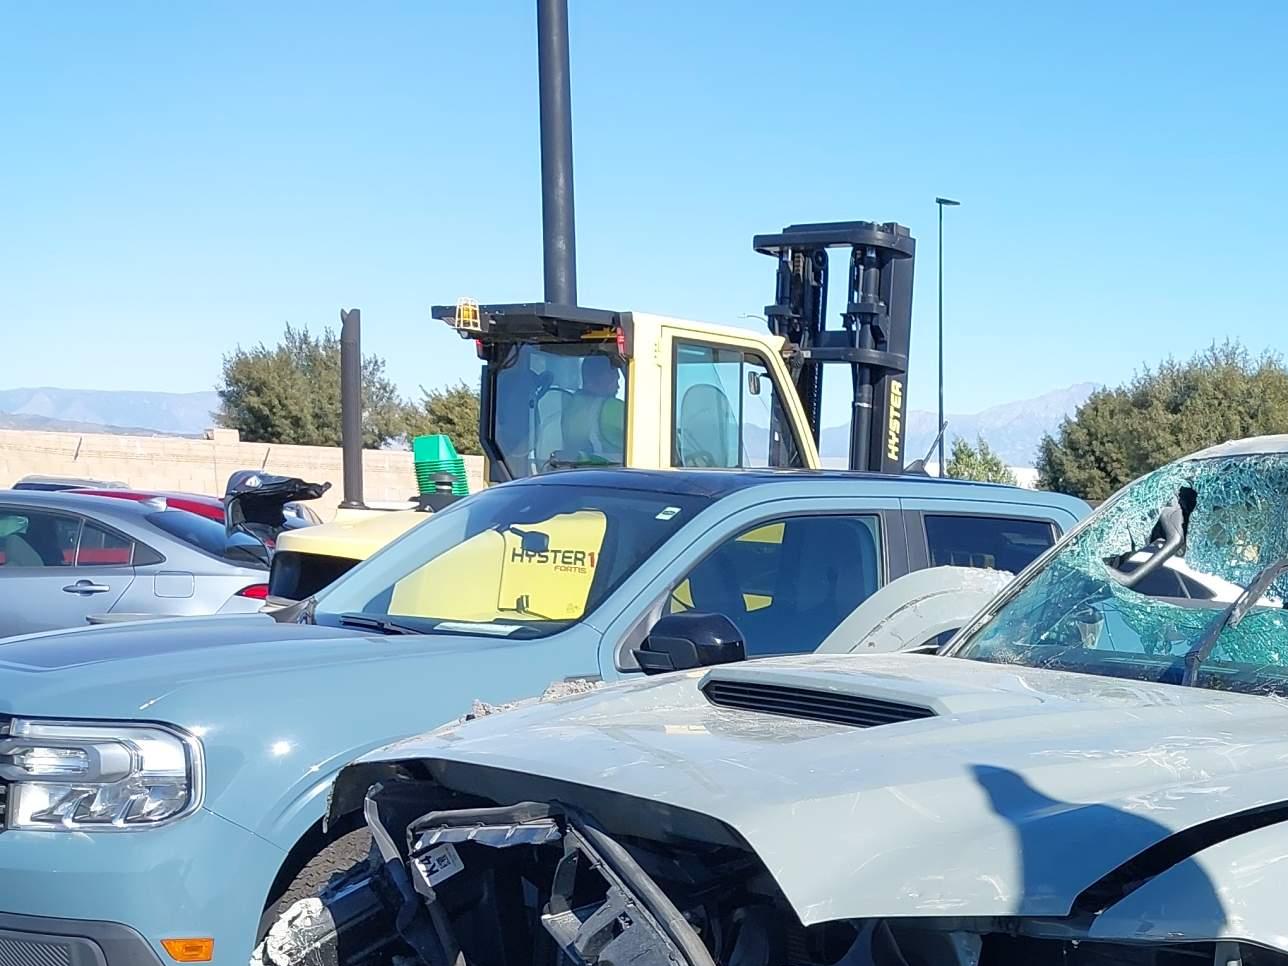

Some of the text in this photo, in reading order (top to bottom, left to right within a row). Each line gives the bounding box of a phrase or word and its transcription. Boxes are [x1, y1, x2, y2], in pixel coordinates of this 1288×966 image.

[888, 380, 903, 461] HYSTER
[511, 547, 586, 566] HYSTER
[554, 565, 587, 574] FORTIS
